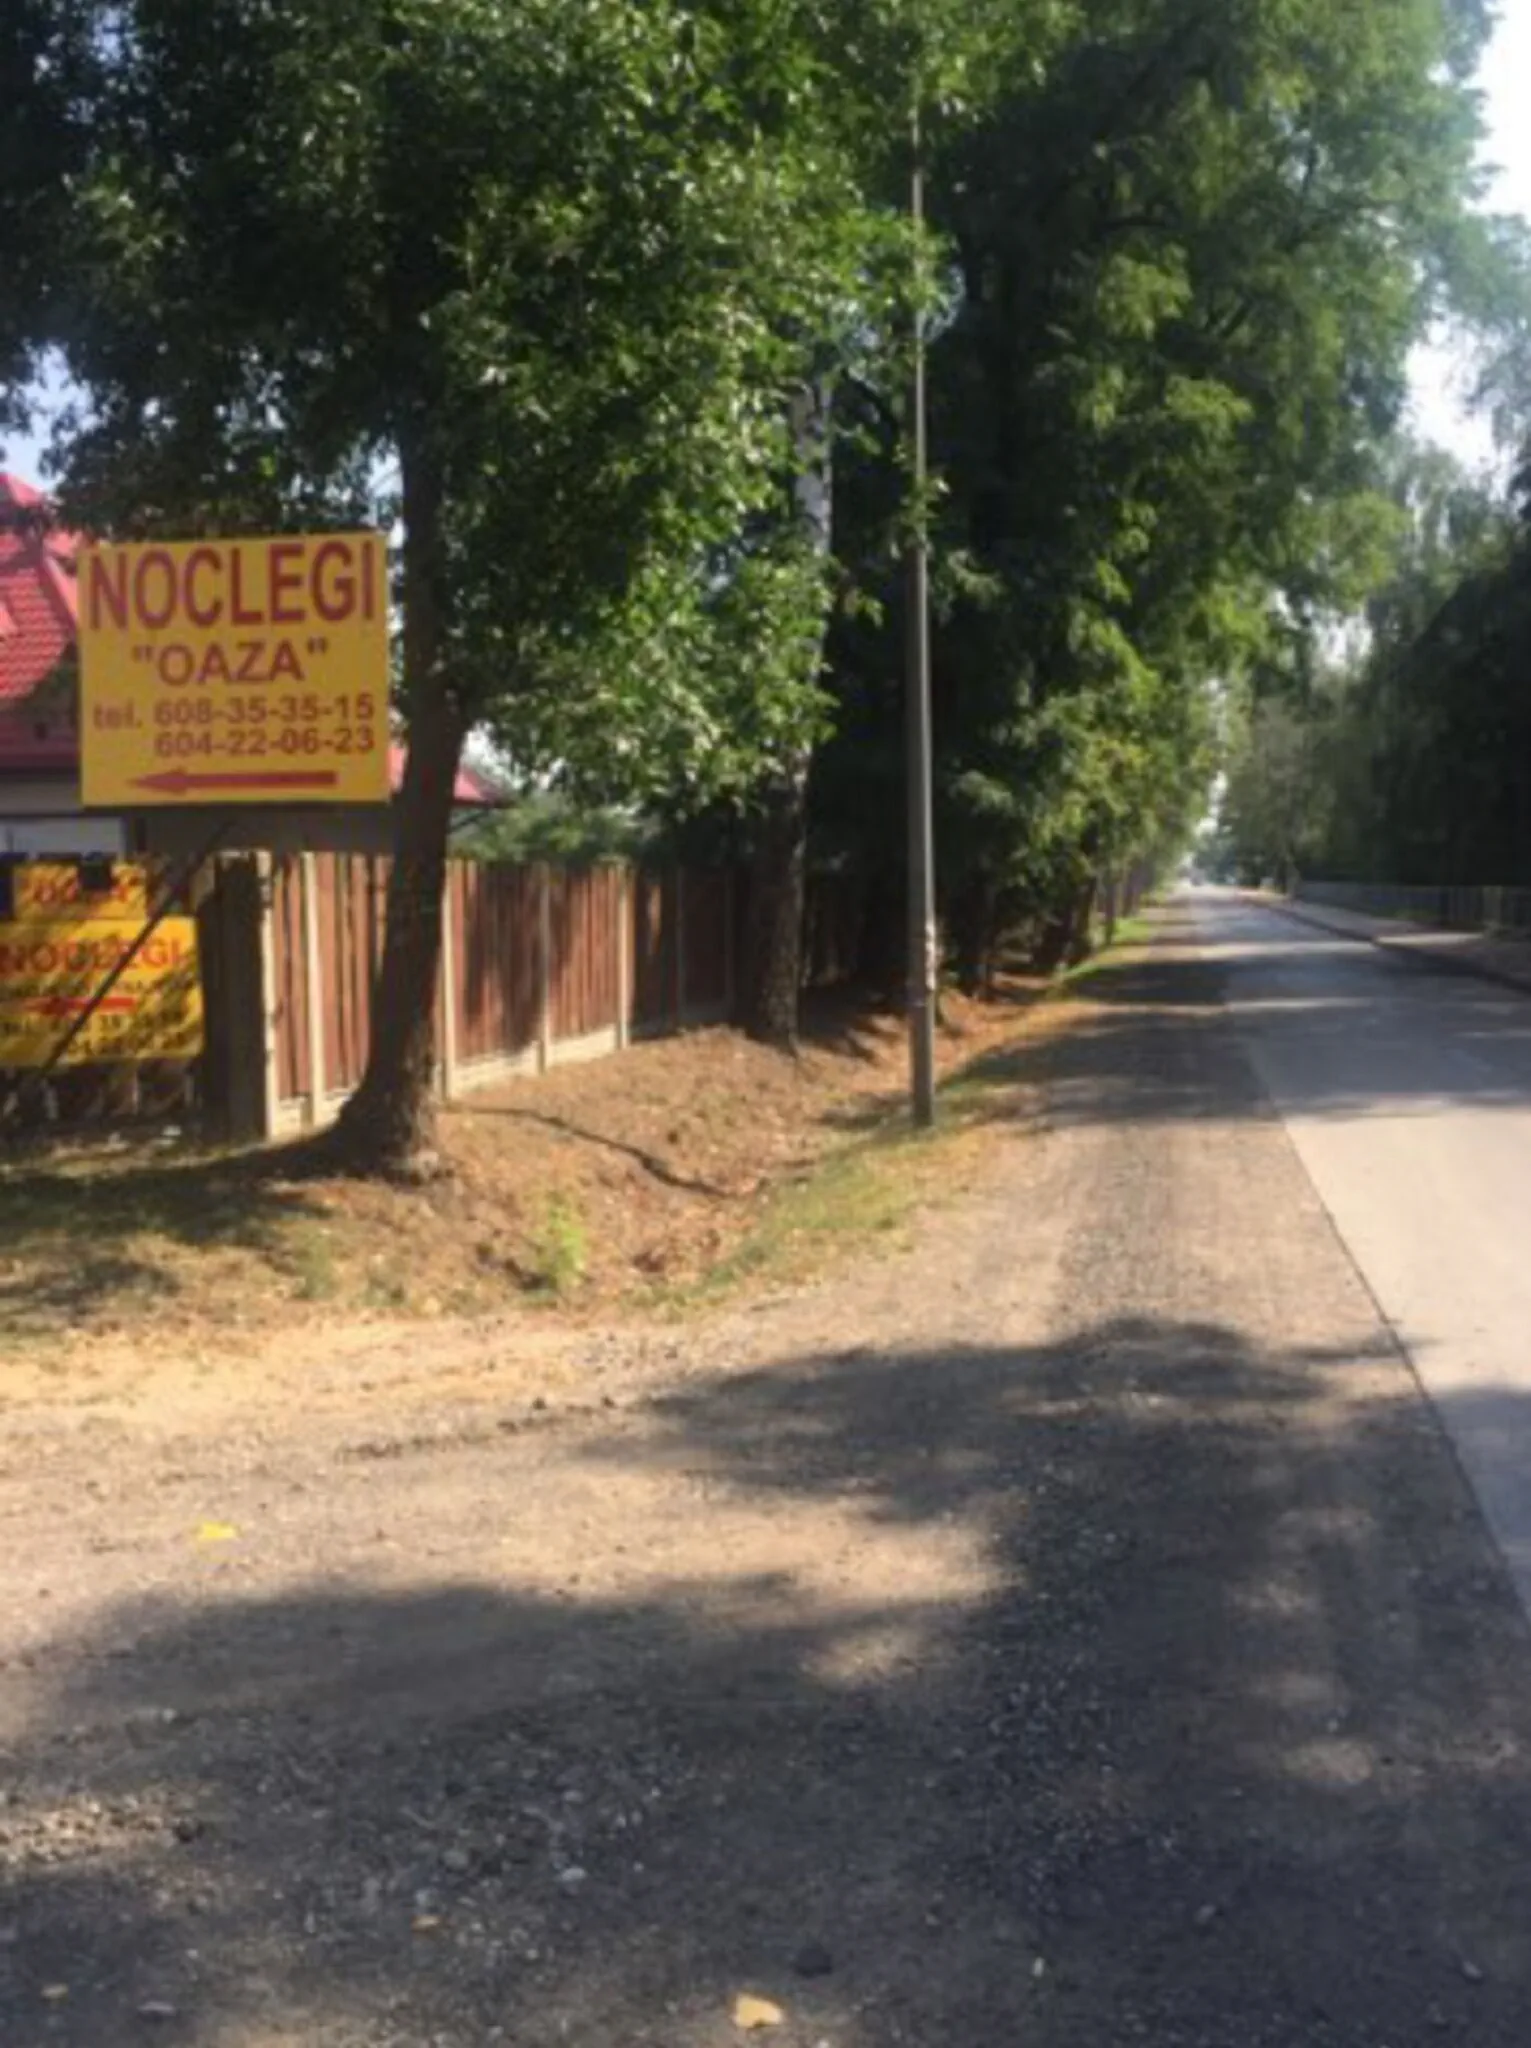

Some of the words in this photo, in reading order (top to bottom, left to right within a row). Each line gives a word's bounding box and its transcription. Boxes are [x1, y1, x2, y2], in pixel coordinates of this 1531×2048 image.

[89, 541, 374, 630] NOCLEGI
[132, 638, 328, 686] "OAZA"
[94, 702, 143, 730] tel.
[154, 727, 374, 757] 604-22-06-23
